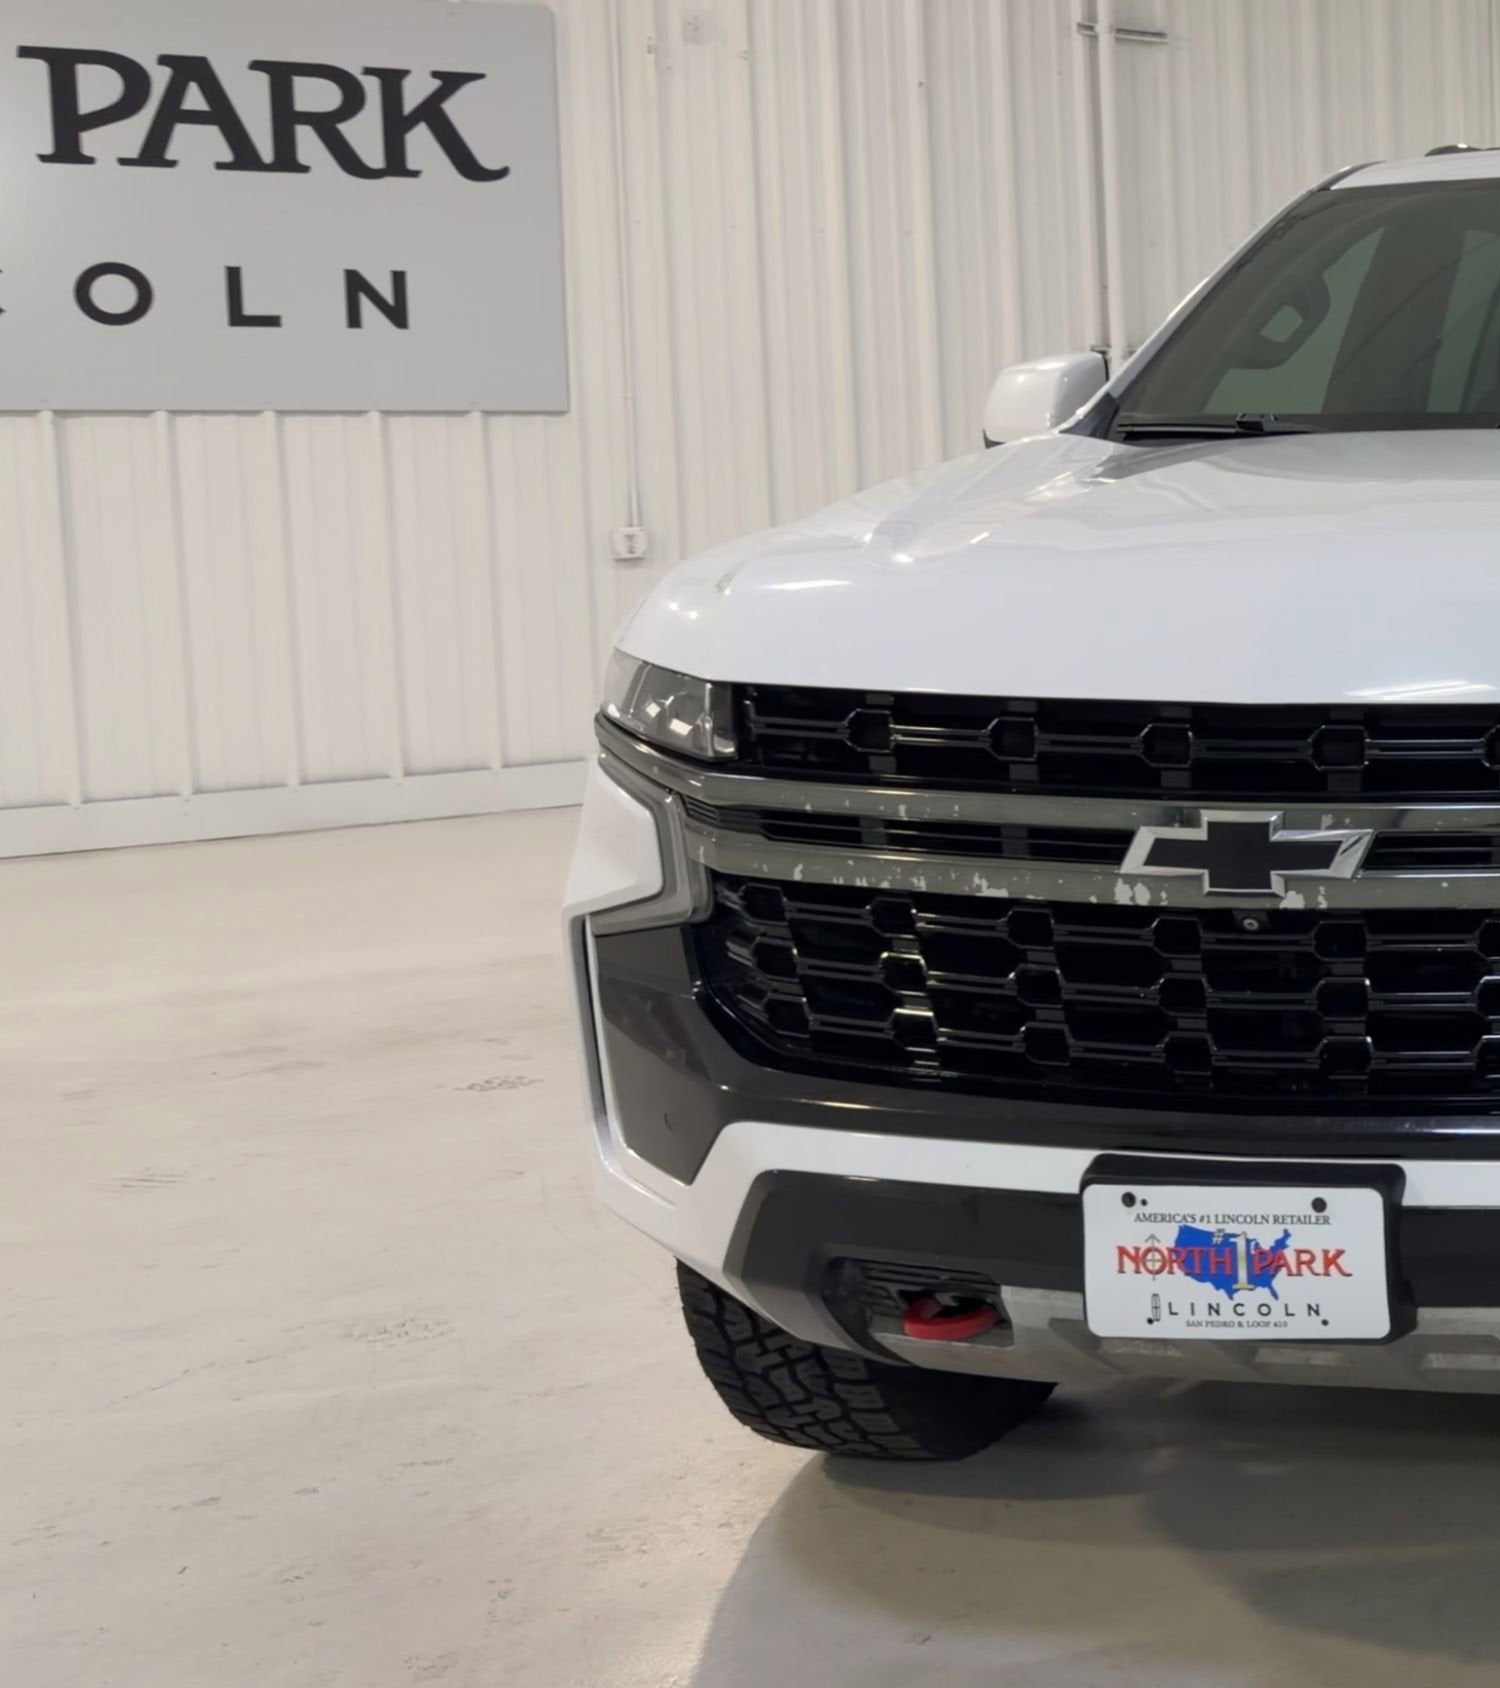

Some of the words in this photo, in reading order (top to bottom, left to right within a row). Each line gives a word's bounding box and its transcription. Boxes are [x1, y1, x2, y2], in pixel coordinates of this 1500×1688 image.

[17, 45, 510, 182] PARK
[0, 261, 410, 330] OLN
[1134, 1213, 1197, 1224] AMERICA'S
[1199, 1214, 1212, 1224] #1
[1215, 1214, 1270, 1225] LINCOLN
[1272, 1215, 1331, 1225] RETAILER
[1116, 1246, 1233, 1276] NORTH
[1253, 1249, 1353, 1277] PARK
[1168, 1302, 1321, 1317] LINCOLN
[1186, 1320, 1203, 1328] SAN
[1205, 1320, 1235, 1328] PEDRO
[1237, 1320, 1244, 1328] &
[1246, 1320, 1271, 1328] LOOP
